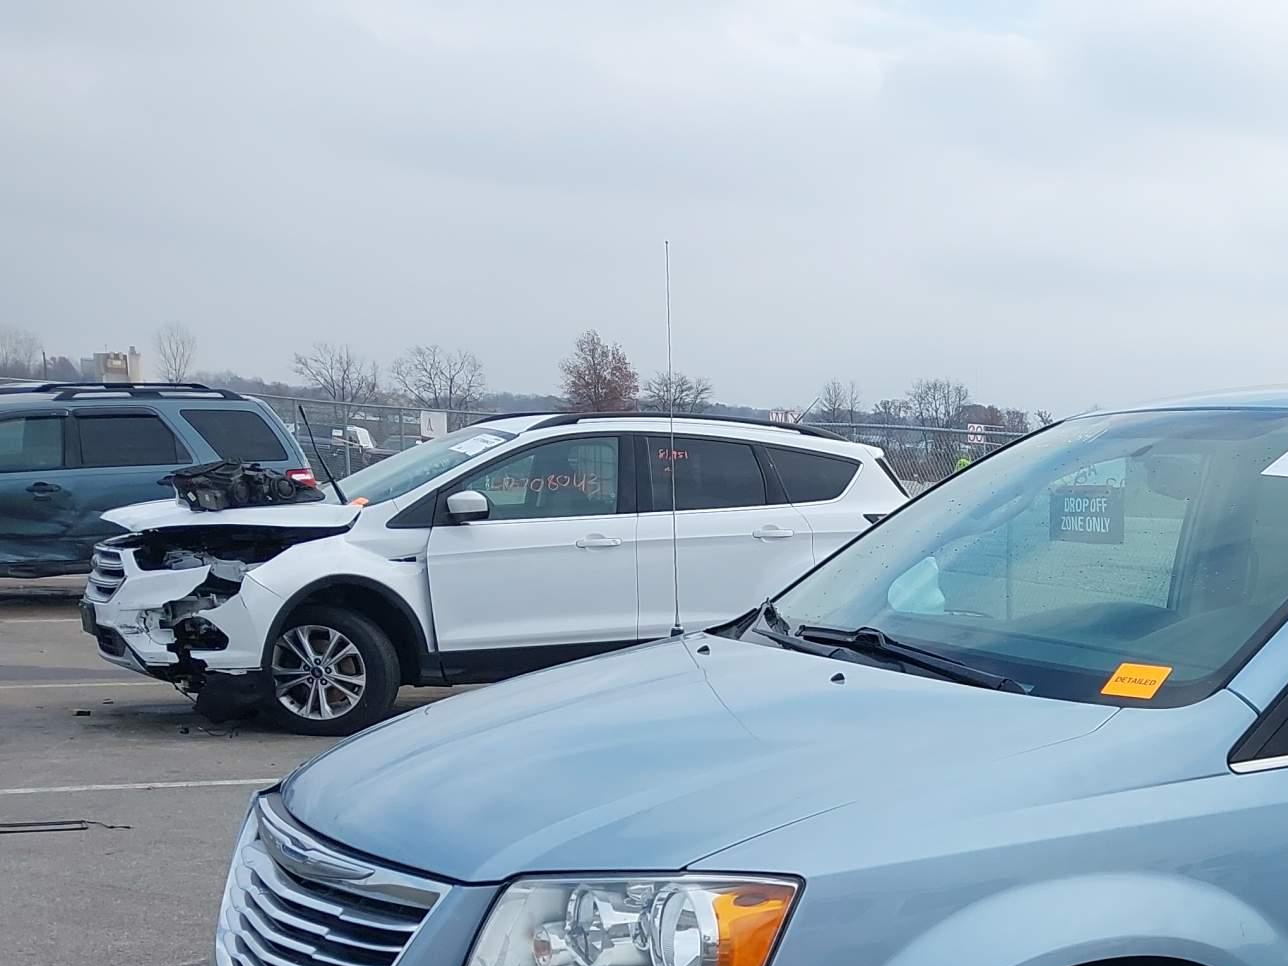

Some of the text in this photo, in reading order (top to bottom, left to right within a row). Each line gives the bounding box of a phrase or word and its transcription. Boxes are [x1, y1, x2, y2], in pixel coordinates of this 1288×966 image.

[1063, 497, 1108, 513] DROP OFF
[1060, 515, 1111, 533] ZONE ONLY
[1114, 676, 1158, 687] DETAILED
